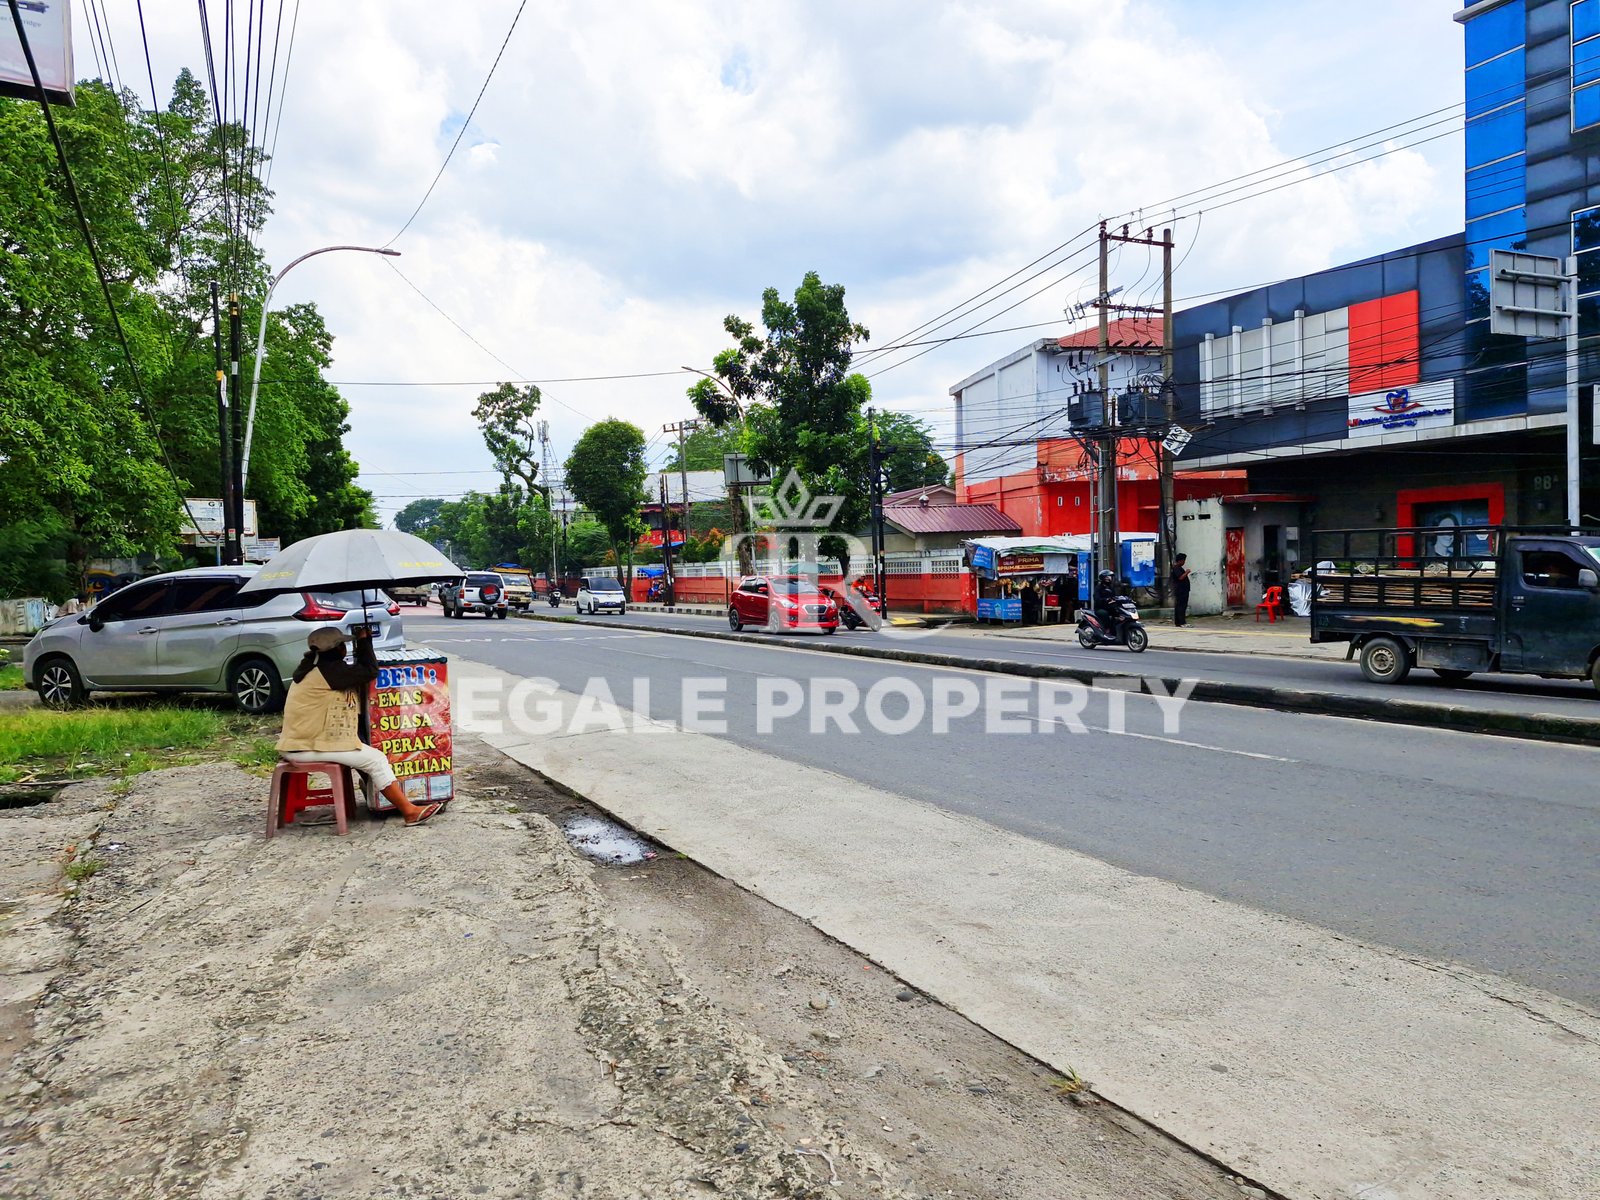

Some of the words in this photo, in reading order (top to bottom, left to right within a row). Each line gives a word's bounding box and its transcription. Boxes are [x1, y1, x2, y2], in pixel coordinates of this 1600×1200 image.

[377, 690, 423, 708] EMAS
[380, 712, 433, 731] SUASA
[381, 735, 436, 755] PERAK
